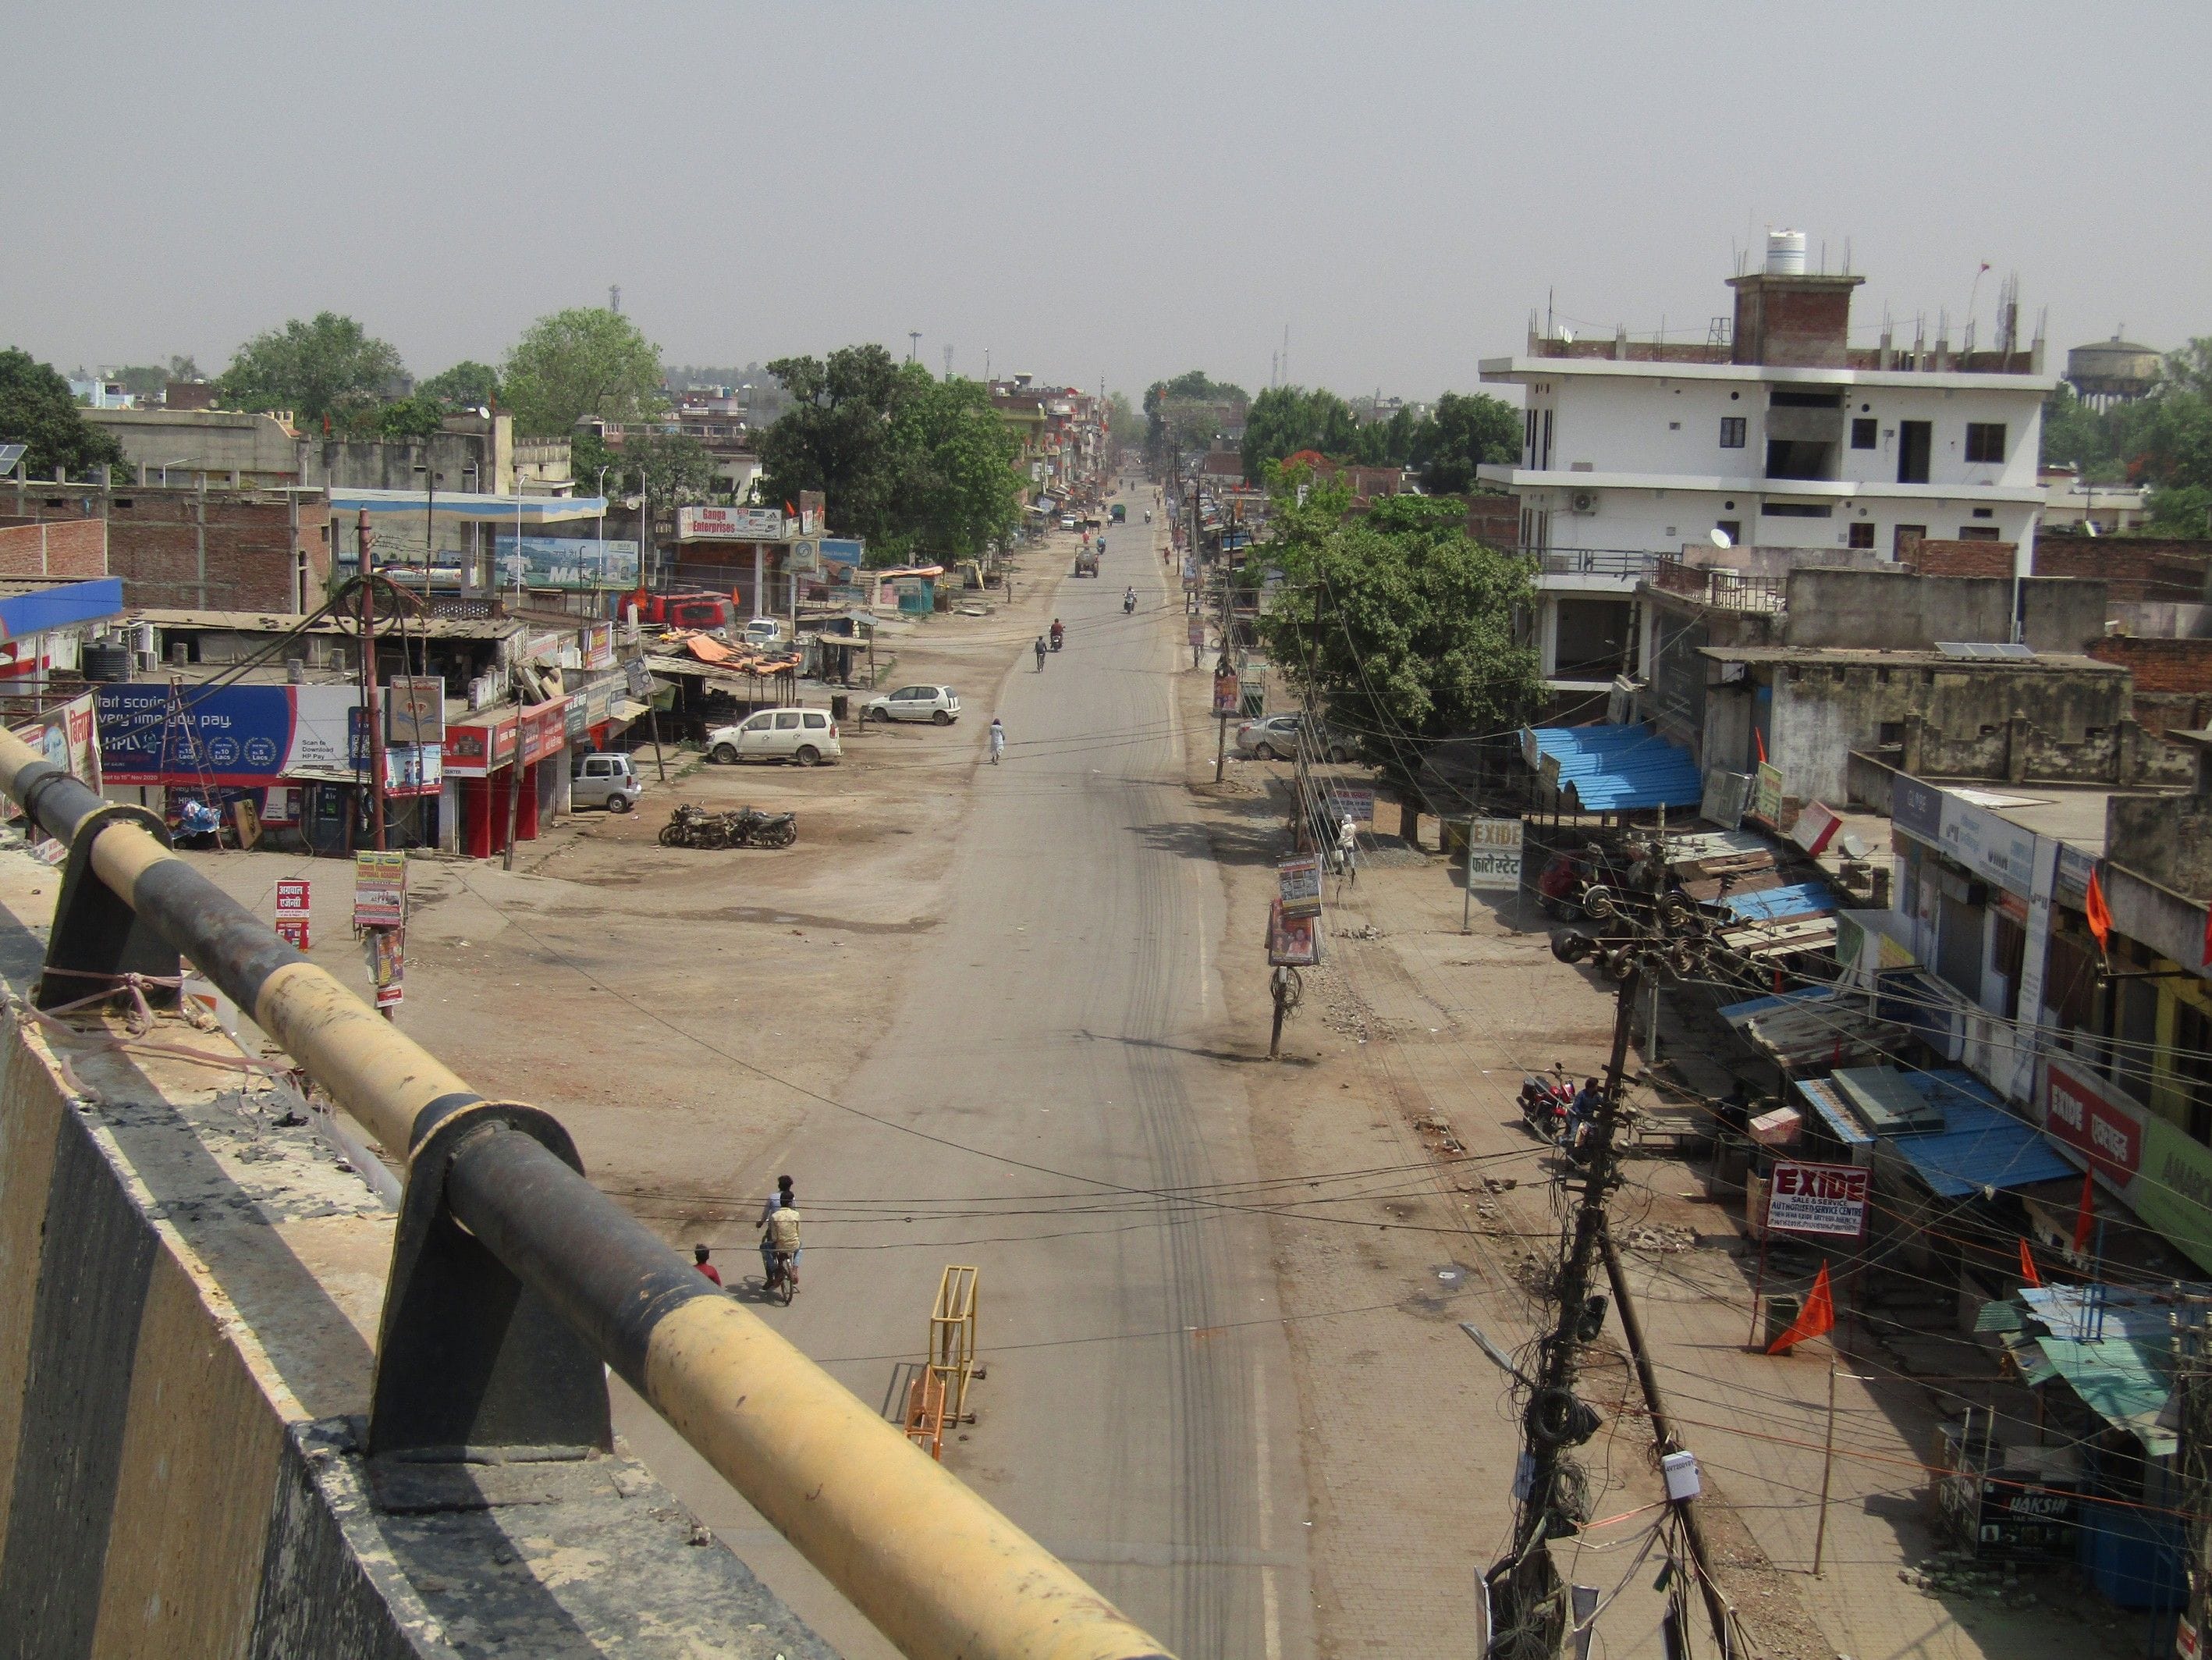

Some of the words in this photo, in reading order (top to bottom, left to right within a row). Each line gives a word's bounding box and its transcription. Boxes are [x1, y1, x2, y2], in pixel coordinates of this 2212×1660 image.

[702, 508, 726, 524] Ganga
[693, 520, 736, 534] Enterprises
[98, 695, 119, 708] tart
[99, 715, 130, 727] very
[201, 713, 232, 728] pay.
[1473, 823, 1521, 846] EXIDE
[2051, 1083, 2083, 1132] EXIDE
[1775, 1168, 1866, 1202] EXIDE
[1817, 1198, 1848, 1207] SERVICE
[1814, 1205, 1837, 1214] SERVICE
[1839, 1207, 1862, 1217] CENTRE
